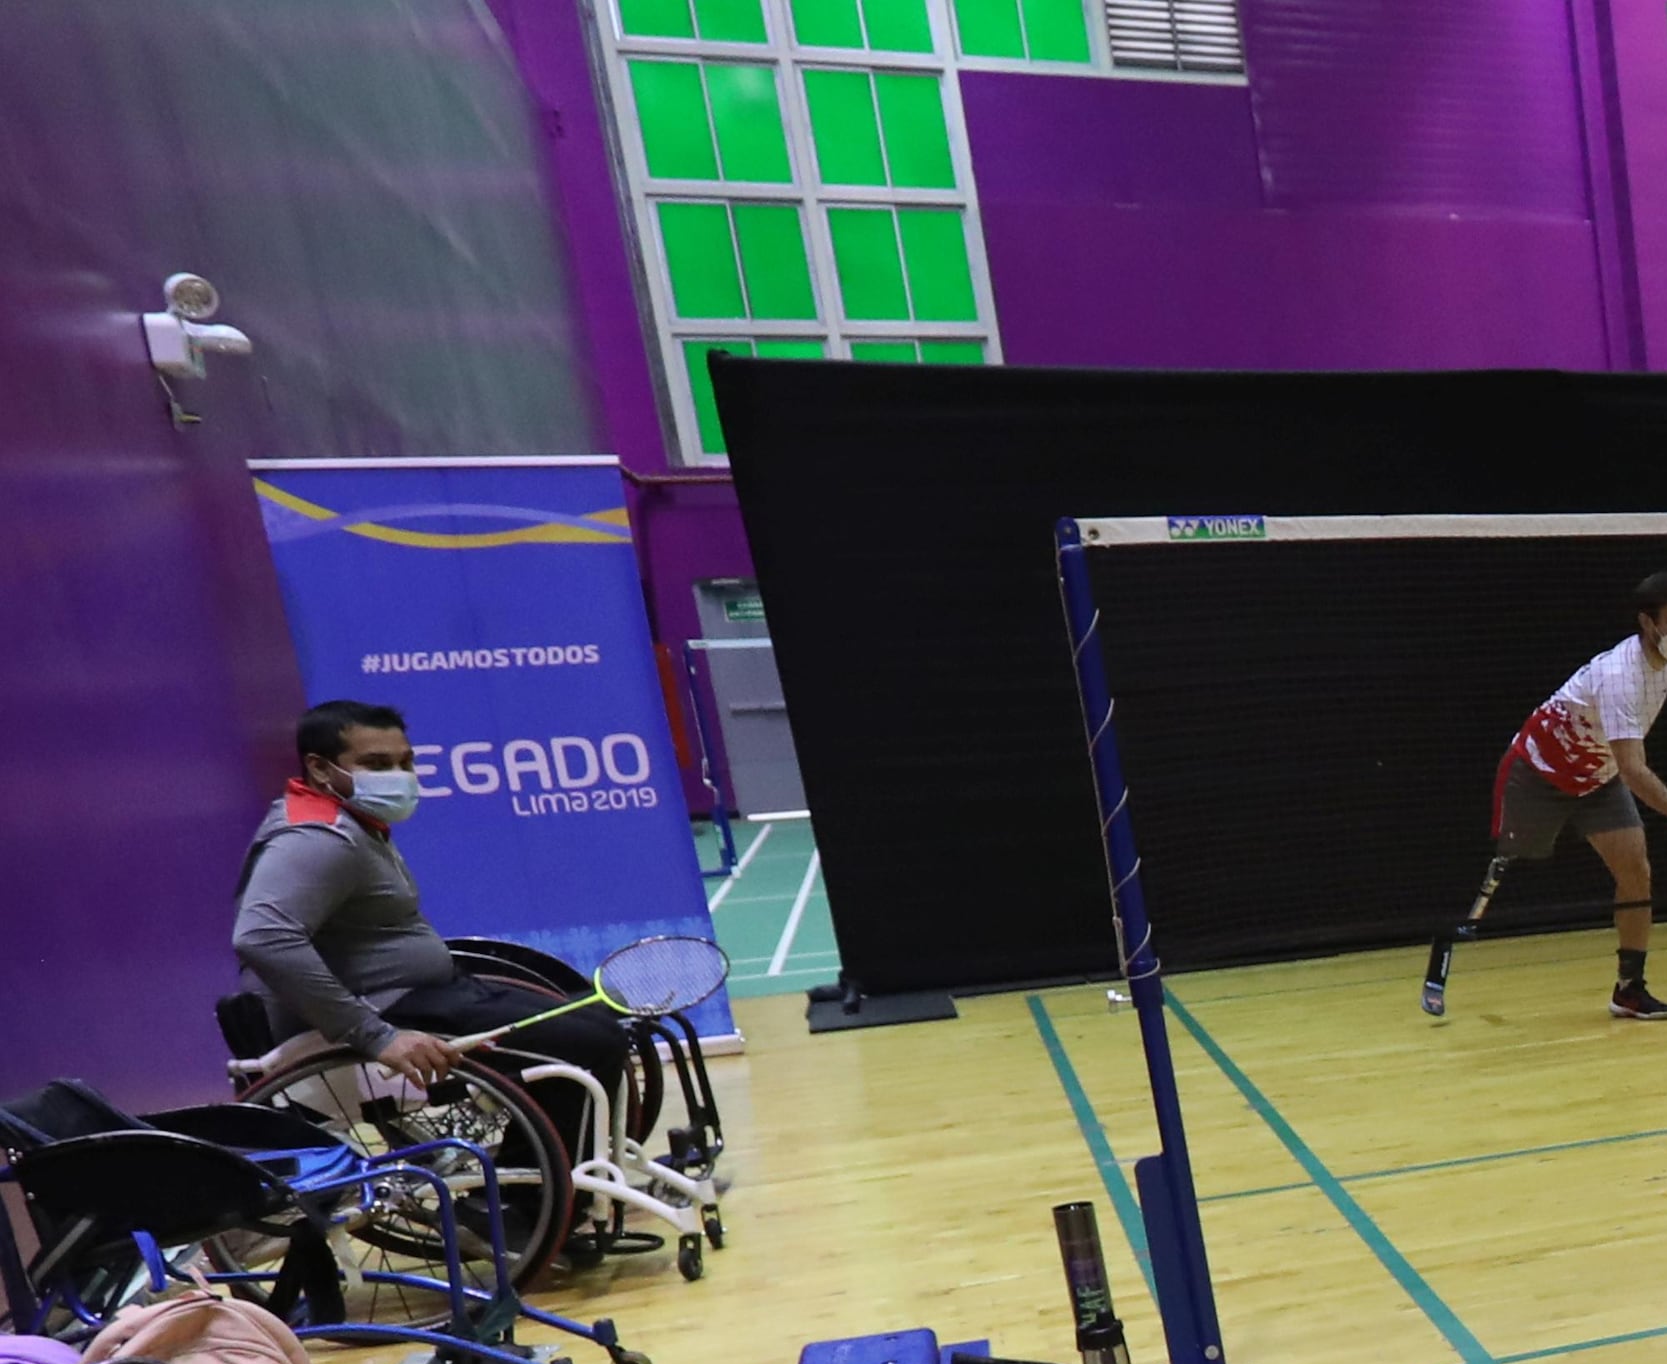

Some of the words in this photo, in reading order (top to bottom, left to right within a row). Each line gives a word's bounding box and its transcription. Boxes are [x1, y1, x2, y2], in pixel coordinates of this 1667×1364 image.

[1205, 518, 1261, 536] YONEX
[361, 645, 599, 673] #JUGAMOSTODOS
[411, 733, 651, 798] EGADO
[590, 786, 658, 811] 2019
